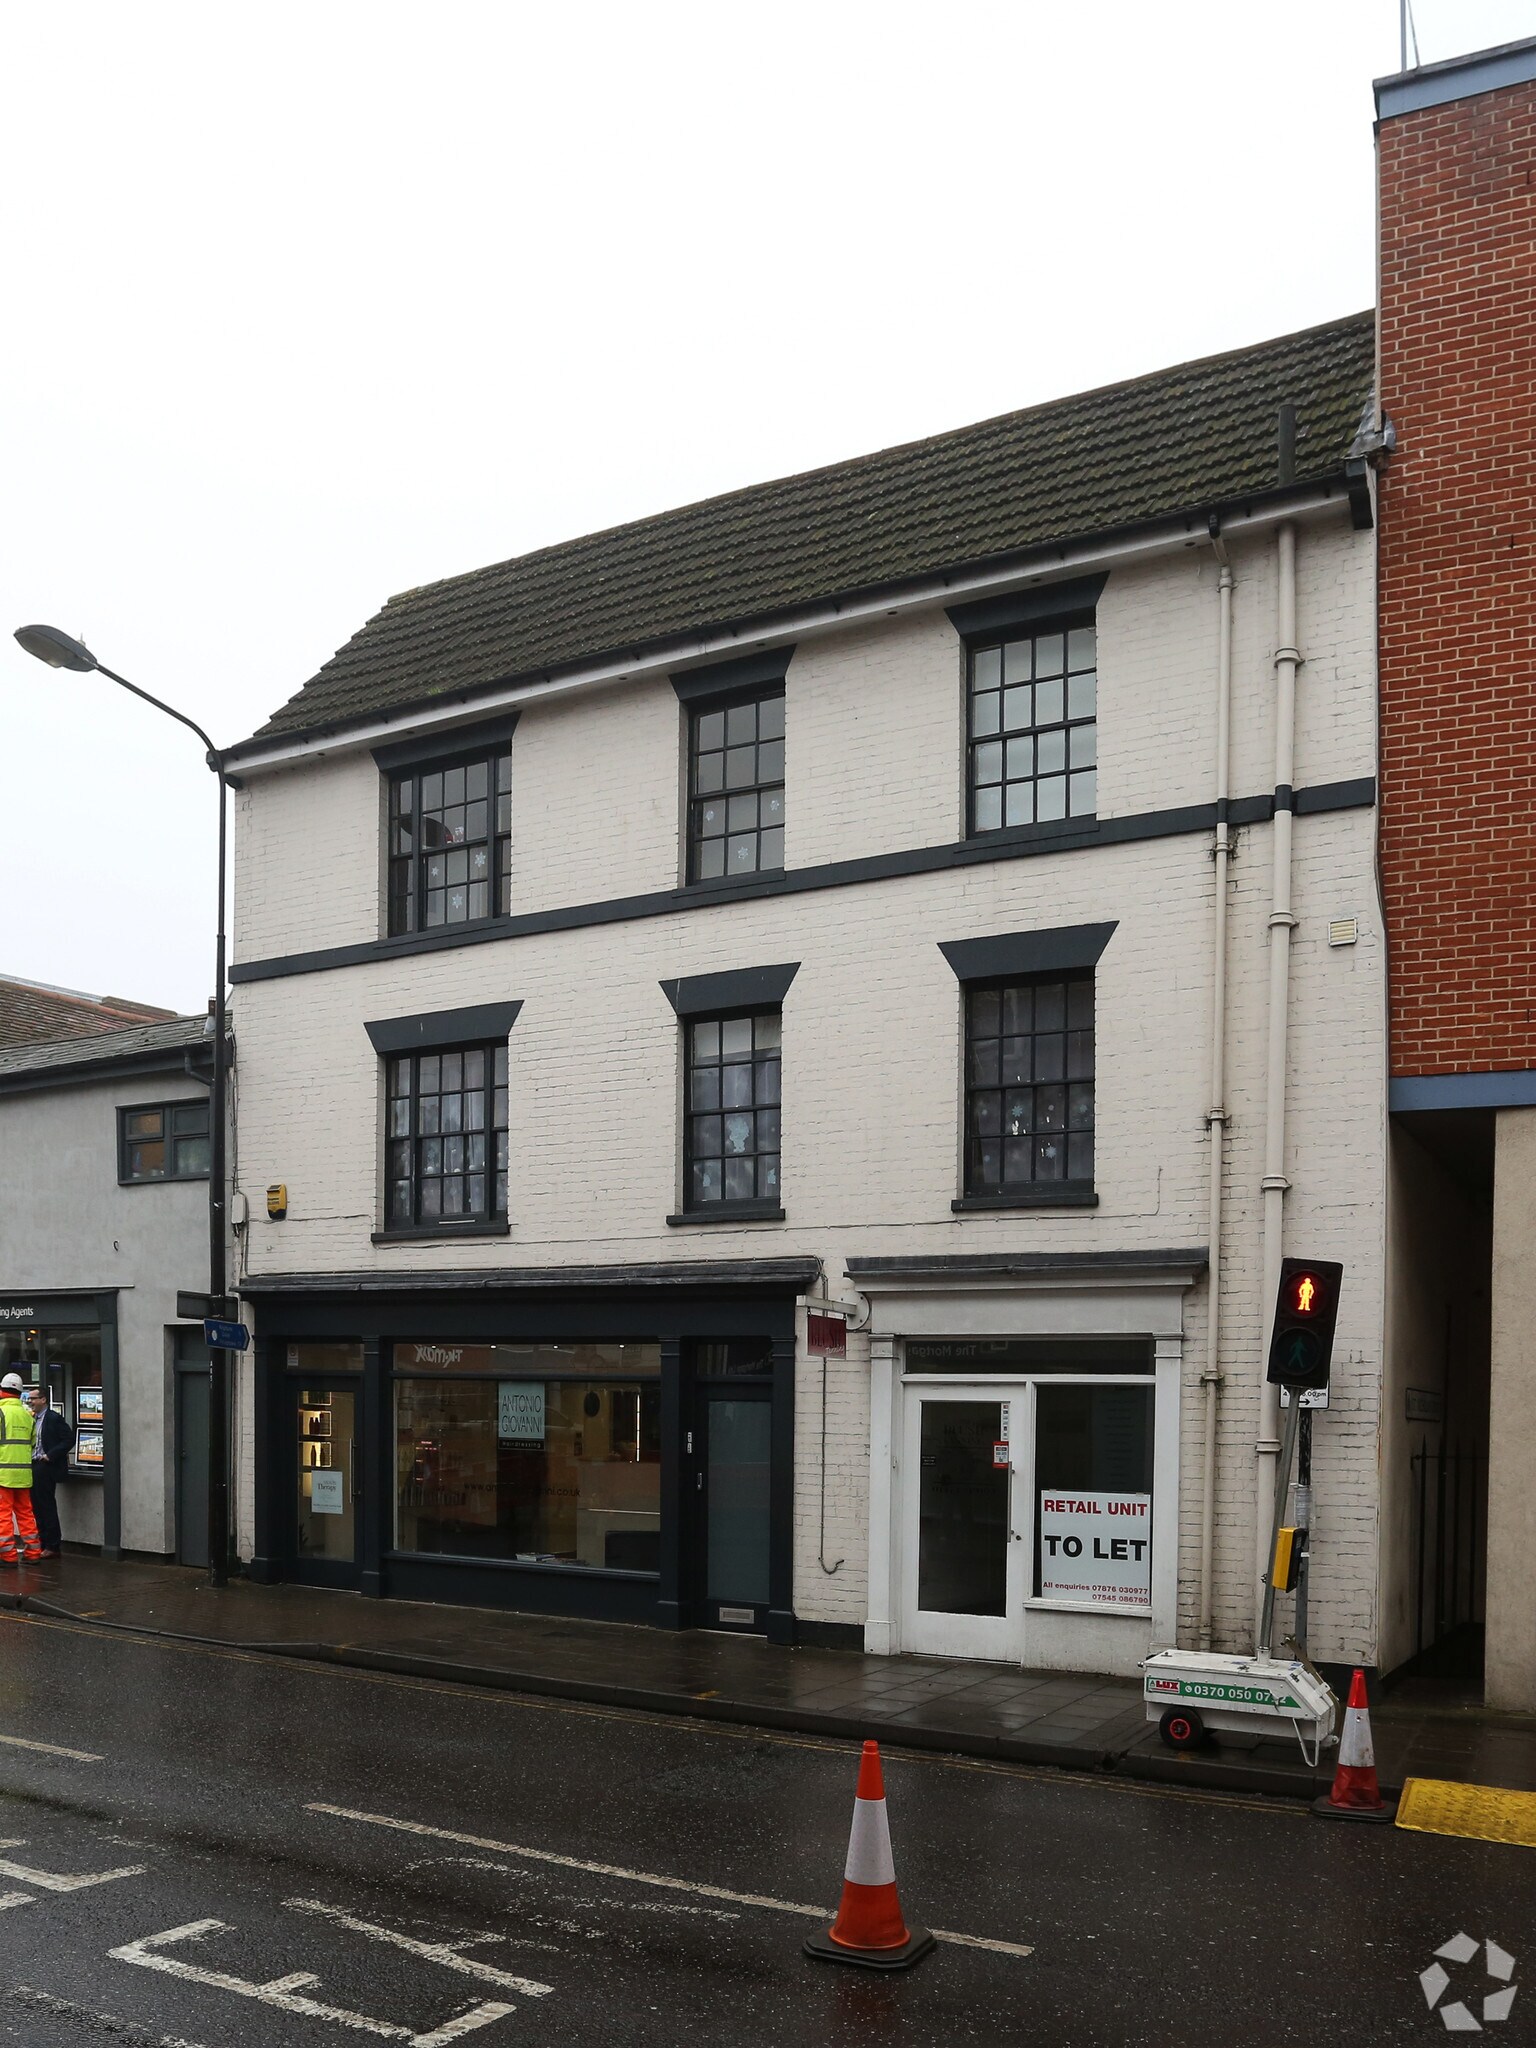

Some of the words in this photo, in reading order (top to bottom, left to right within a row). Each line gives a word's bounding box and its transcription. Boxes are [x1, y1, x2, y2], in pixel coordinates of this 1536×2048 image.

[10, 1306, 34, 1319] Agents
[501, 1394, 542, 1413] ANTONIO
[501, 1414, 542, 1433] GIOVANNI
[1044, 1499, 1101, 1514] RETAIL
[1107, 1502, 1147, 1516] UNIT
[1044, 1534, 1083, 1558] TO
[1093, 1537, 1147, 1561] LET
[1043, 1581, 1053, 1589] All
[1055, 1583, 1090, 1591] enquiries
[1118, 1587, 1148, 1595] 030977
[1118, 1595, 1148, 1603] 086790
[1155, 1680, 1179, 1690] LUX
[1194, 1685, 1225, 1698] 0370
[1228, 1688, 1252, 1700] 050
[1256, 1691, 1286, 1704] 072
